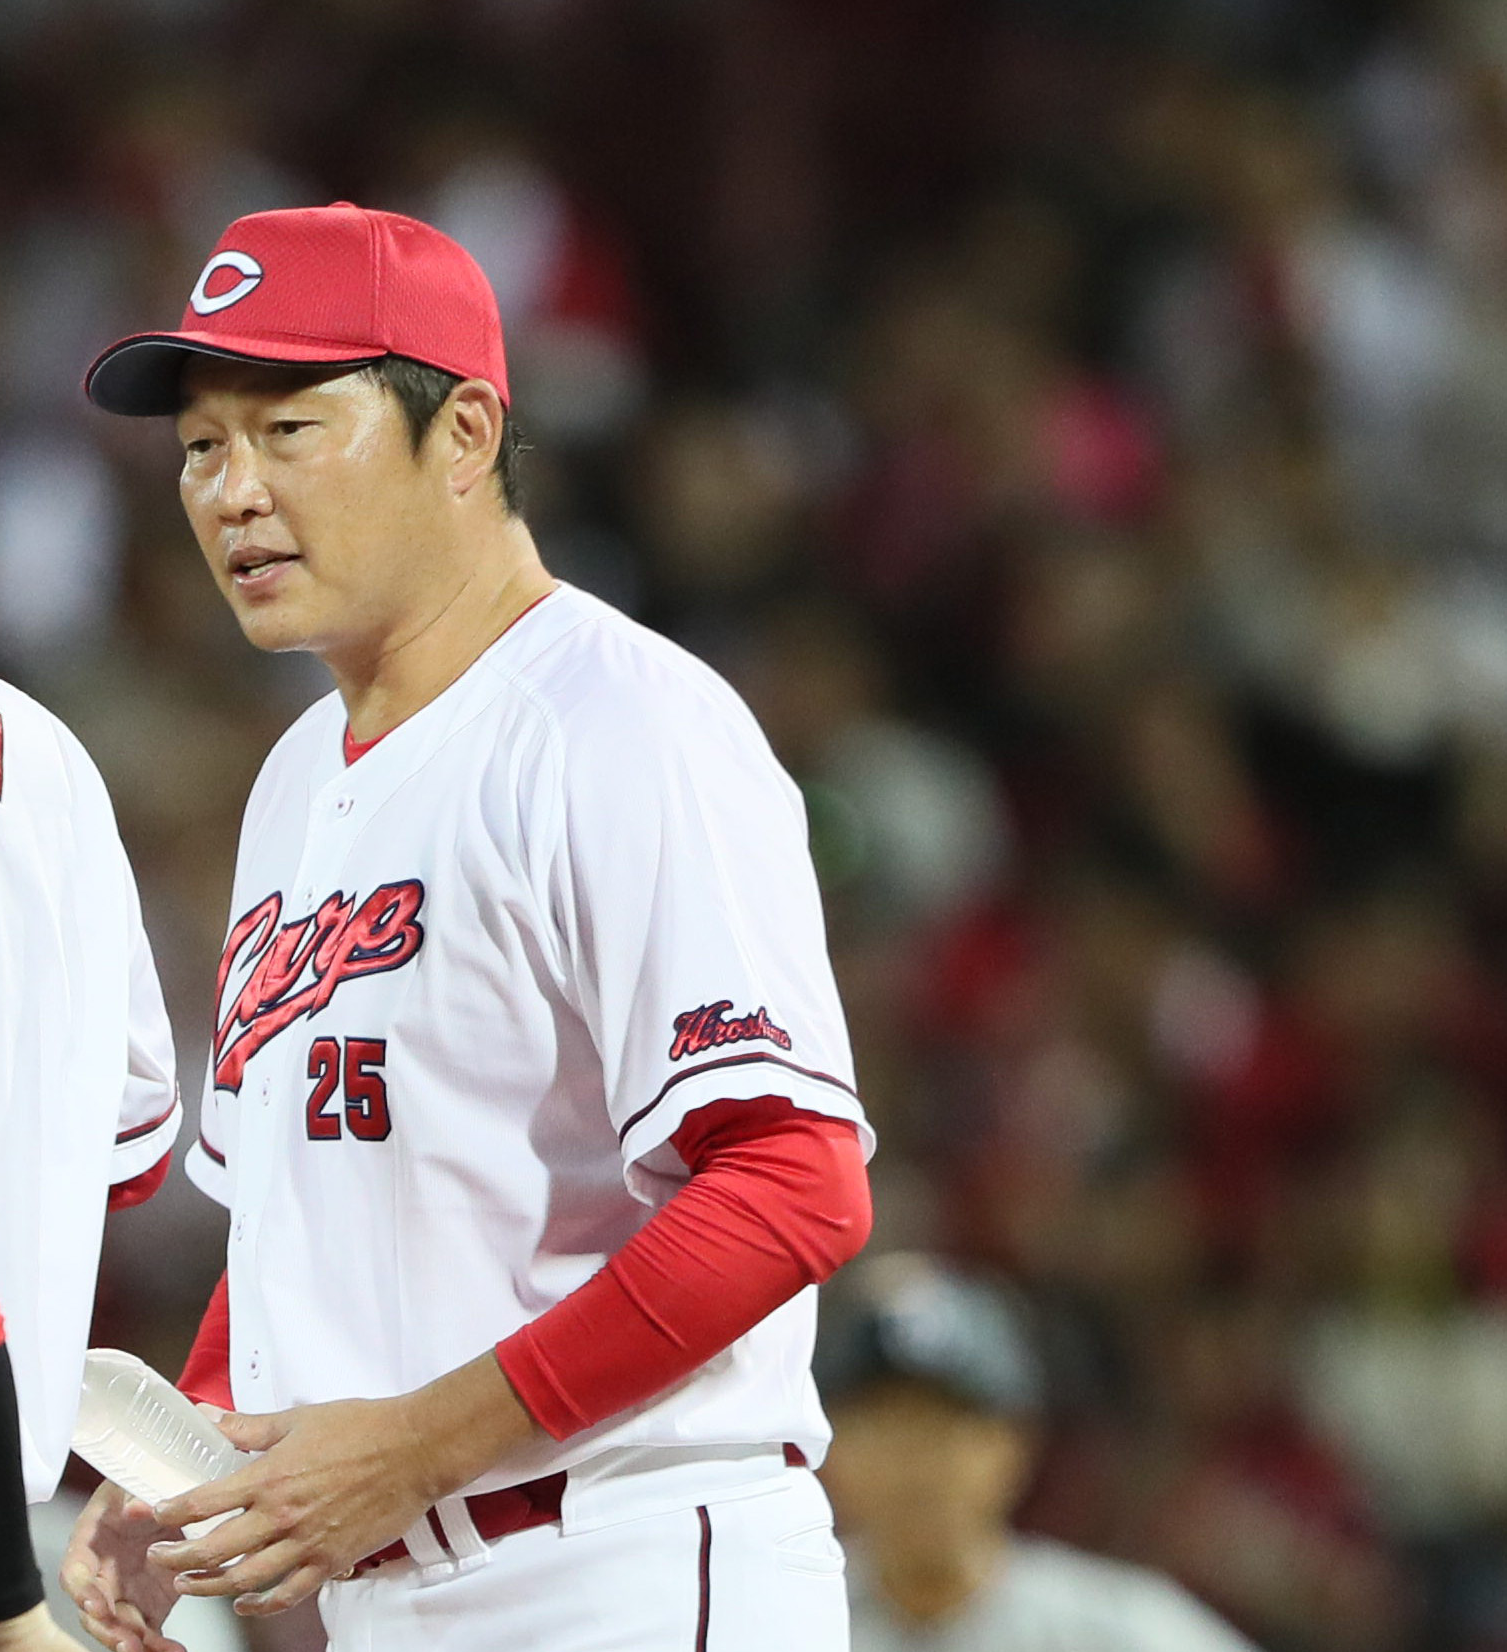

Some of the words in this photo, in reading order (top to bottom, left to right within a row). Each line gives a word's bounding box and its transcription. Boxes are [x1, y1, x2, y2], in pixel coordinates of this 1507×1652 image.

[188, 249, 264, 317] C
[213, 878, 425, 1098] Carp
[668, 999, 792, 1062] Hiroshima
[306, 1035, 392, 1142] 25
